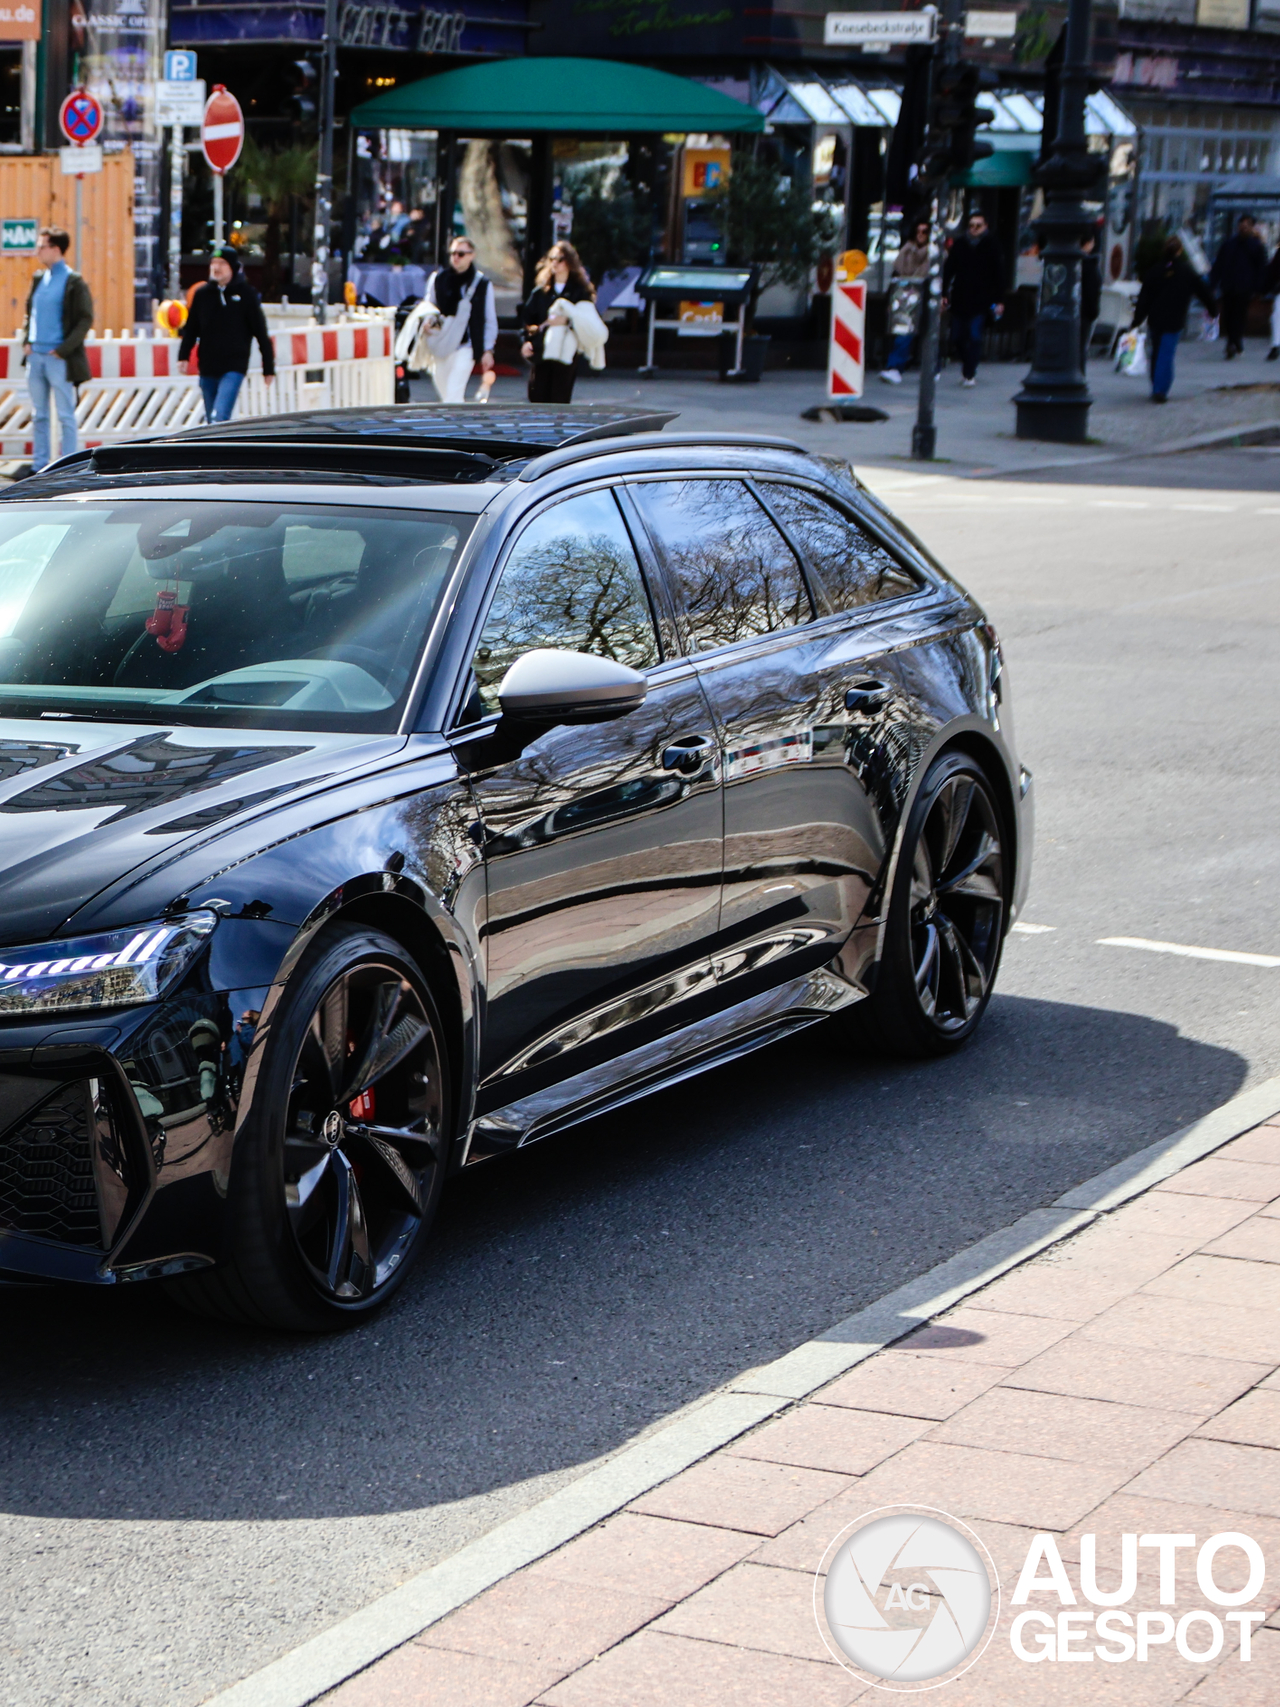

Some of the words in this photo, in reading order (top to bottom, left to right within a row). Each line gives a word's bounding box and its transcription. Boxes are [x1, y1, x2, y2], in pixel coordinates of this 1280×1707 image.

[419, 10, 467, 52] BAR
[833, 19, 926, 37] Knesebeckstraße
[171, 54, 190, 79] P
